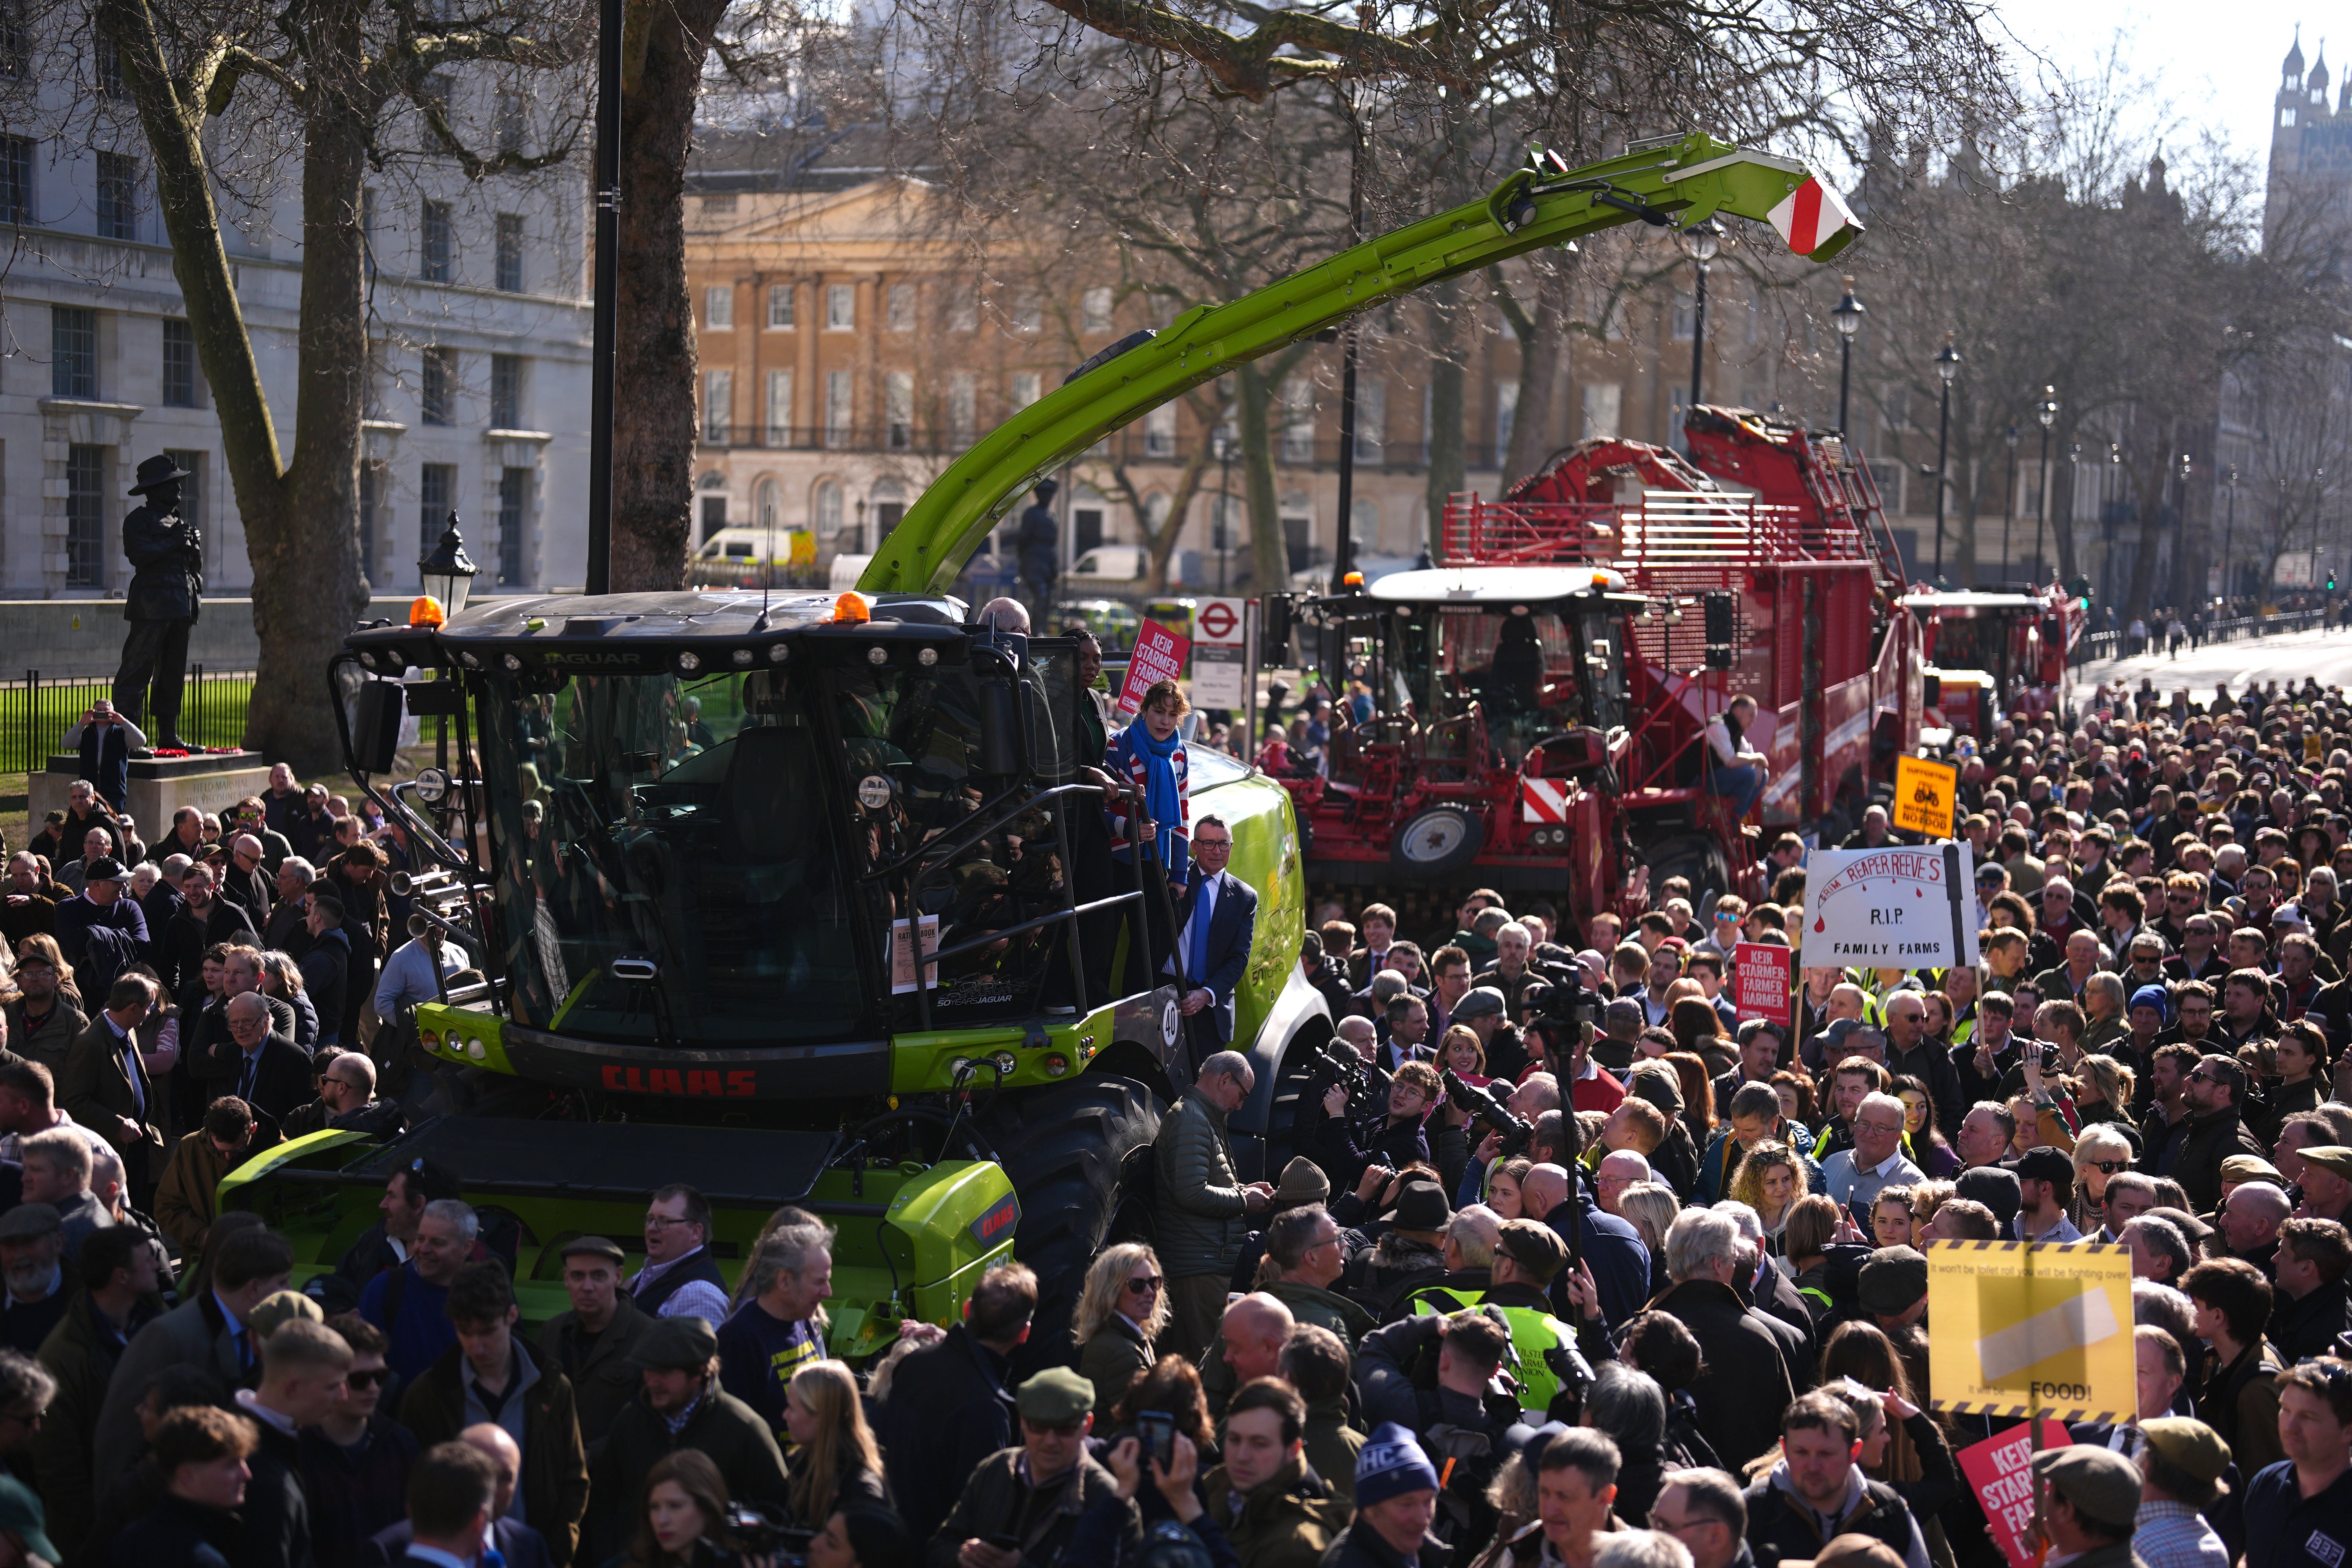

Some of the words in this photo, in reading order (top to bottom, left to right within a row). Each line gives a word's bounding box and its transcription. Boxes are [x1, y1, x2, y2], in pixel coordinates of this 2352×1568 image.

[1152, 632, 1173, 655] KEIR
[544, 653, 641, 664] JAGUAR
[1136, 642, 1179, 677] STARMER:
[1907, 766, 1950, 781] SUPPORTING
[194, 781, 213, 793] FIELD
[215, 778, 248, 789] MARSHAL
[187, 797, 198, 806] THE
[201, 792, 236, 804] VISCOUNT
[1903, 812, 1917, 822] NO
[1919, 816, 1947, 830] FOOD
[1916, 806, 1947, 819] FARMERS
[1820, 880, 1841, 902] GRIM
[1847, 855, 1889, 882] REAPER
[1871, 908, 1903, 925] R.I.P.
[920, 928, 935, 937] BOOK
[1834, 943, 1889, 954] FAMILY
[1899, 942, 1940, 954] FARMS
[1751, 950, 1773, 965] KEIR
[1739, 963, 1788, 981] STARMER:
[1744, 977, 1782, 994] FARMER
[1742, 991, 1784, 1008] HARMER
[1166, 1007, 1175, 1037] 40
[602, 1065, 756, 1096] CLAAS
[983, 1203, 1014, 1238] CLAAS
[1931, 1263, 1936, 1272] It
[1938, 1264, 1962, 1273] won't
[1963, 1265, 1975, 1274] be
[1977, 1265, 1999, 1274] toilet
[2000, 1266, 2015, 1275] roll
[2017, 1268, 2033, 1278] you
[2036, 1267, 2051, 1276] will
[2054, 1267, 2065, 1277] be
[2068, 1268, 2103, 1280] fighting
[1515, 1367, 1544, 1377] UNION
[2031, 1381, 2092, 1402] FOOD!
